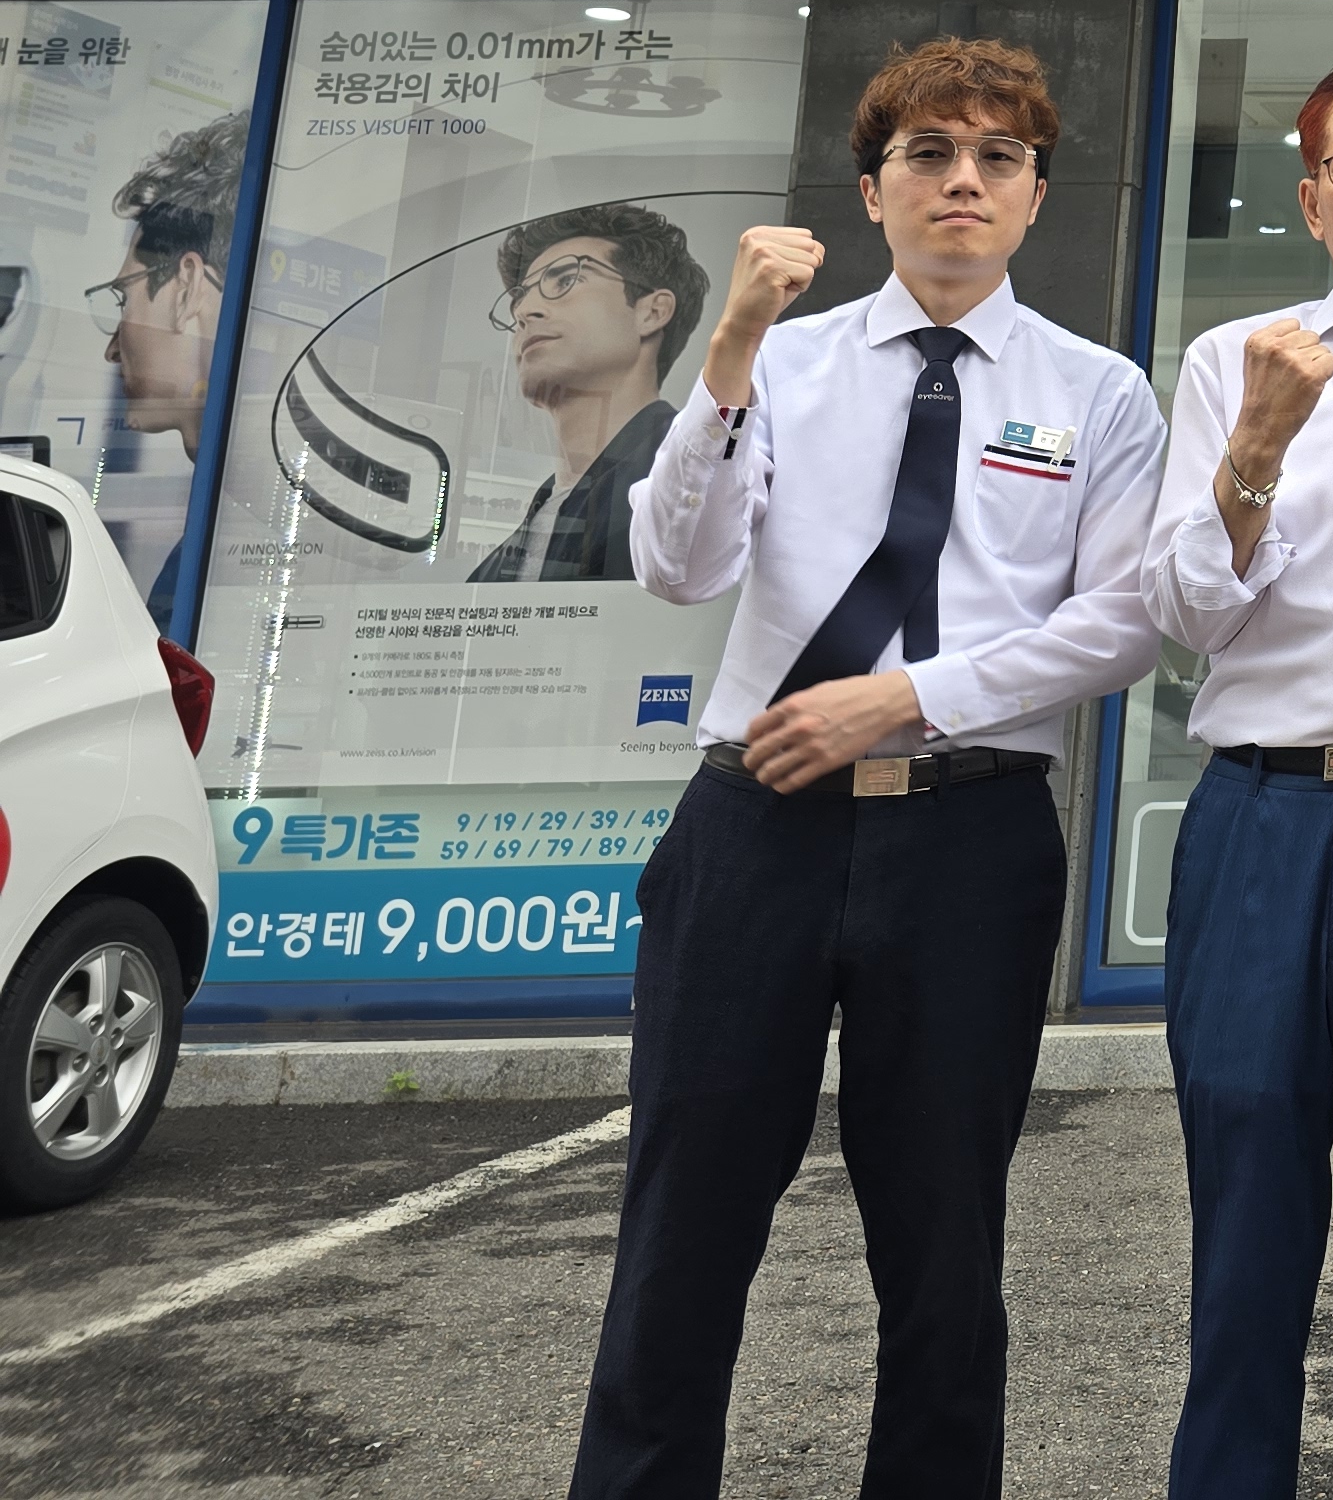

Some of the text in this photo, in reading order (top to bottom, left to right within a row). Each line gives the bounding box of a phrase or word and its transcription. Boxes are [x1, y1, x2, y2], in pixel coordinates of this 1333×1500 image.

[17, 38, 70, 65] 눈을
[79, 38, 131, 66] 위한
[320, 30, 674, 62] 숨어있는 0.01mm가 주는
[314, 71, 500, 105] 착용감의 차이
[307, 119, 486, 136] ZEISS VISUFIT 1000
[917, 393, 955, 401] eyesaver
[357, 606, 599, 621] 디지털 방식의 전문적 컨설팅과 정밀한 개별 피팅으로
[355, 624, 519, 639] 선명한 시야와 착용감을 선사합니다.
[641, 689, 690, 702] ZEISS
[340, 747, 436, 759] www.zeiss.co.kr/vision
[620, 741, 656, 754] Seeing
[457, 809, 670, 832] 9 19 29 39 49
[233, 807, 421, 865] 9 특가존
[440, 837, 627, 860] 59 69 79 89
[226, 911, 365, 959] 안경테
